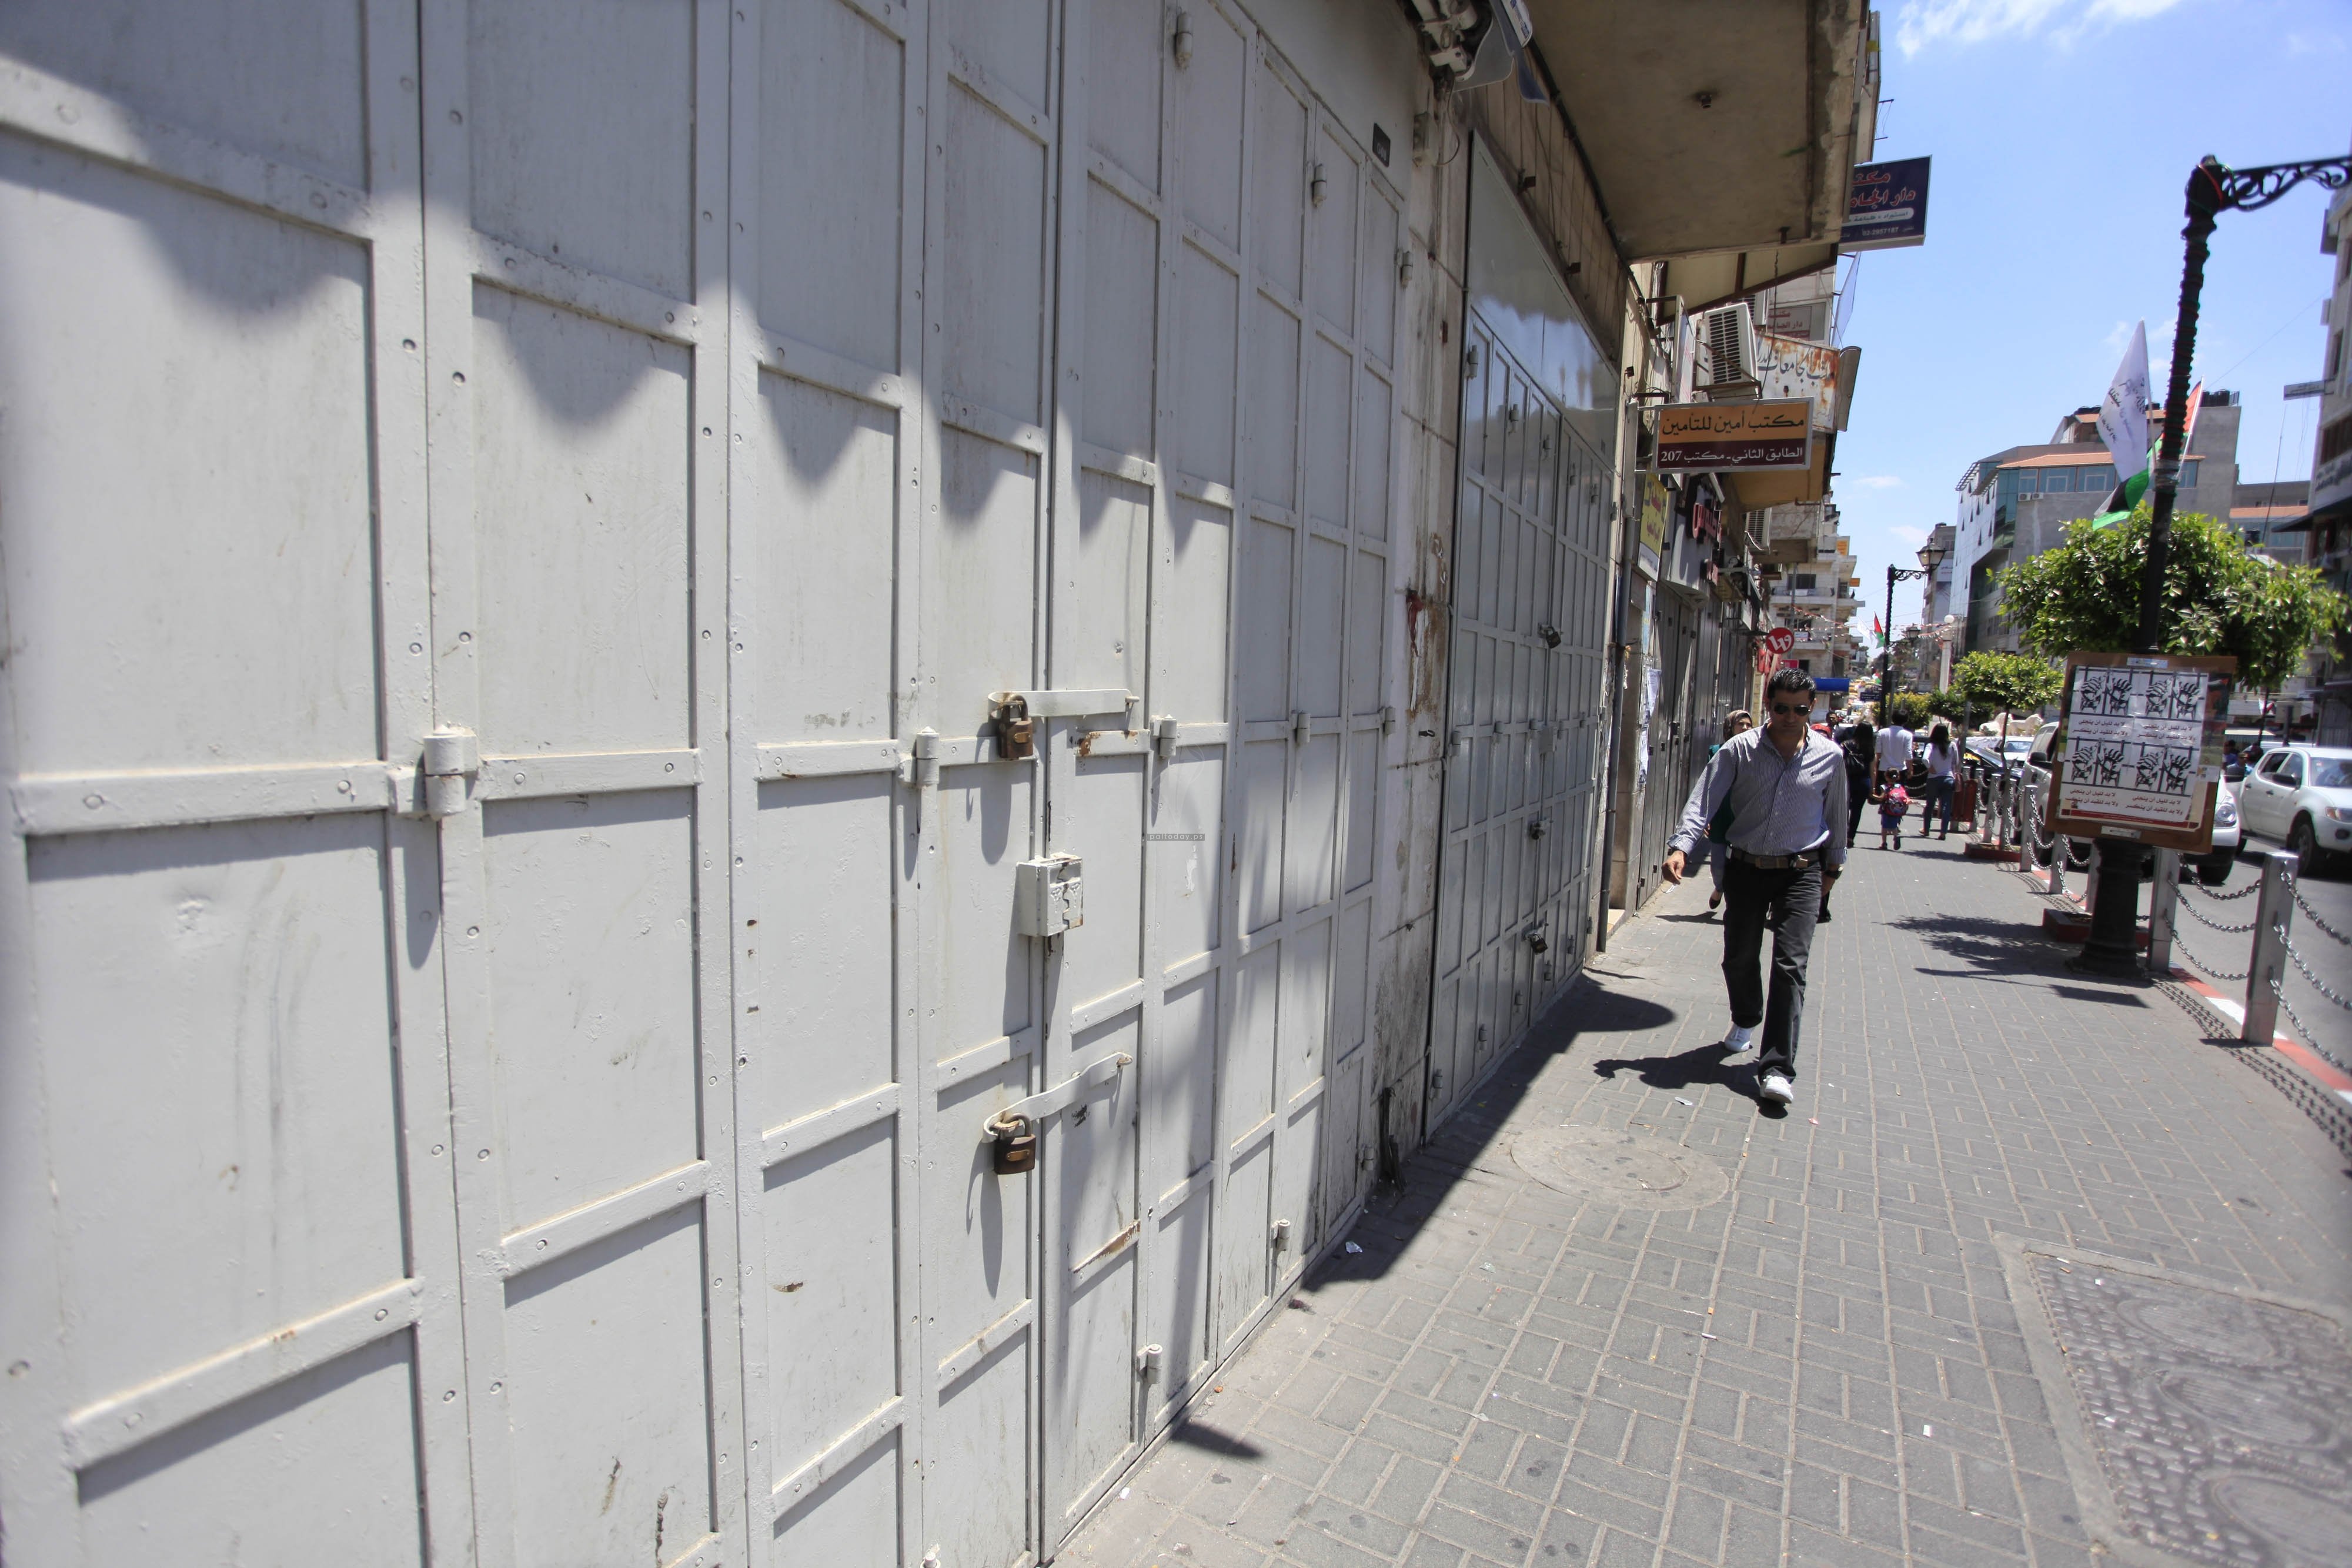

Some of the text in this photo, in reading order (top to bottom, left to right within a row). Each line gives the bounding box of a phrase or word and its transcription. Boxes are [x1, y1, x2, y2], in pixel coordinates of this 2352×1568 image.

[1850, 186, 1917, 209] دار الجام
[1663, 413, 1712, 435] للتأمين
[1748, 414, 1804, 433] مكتب
[1661, 450, 1682, 461] 207
[1683, 450, 1724, 463] مكتب
[1732, 448, 1763, 463] الثاني
[1766, 447, 1802, 461] الطابق
